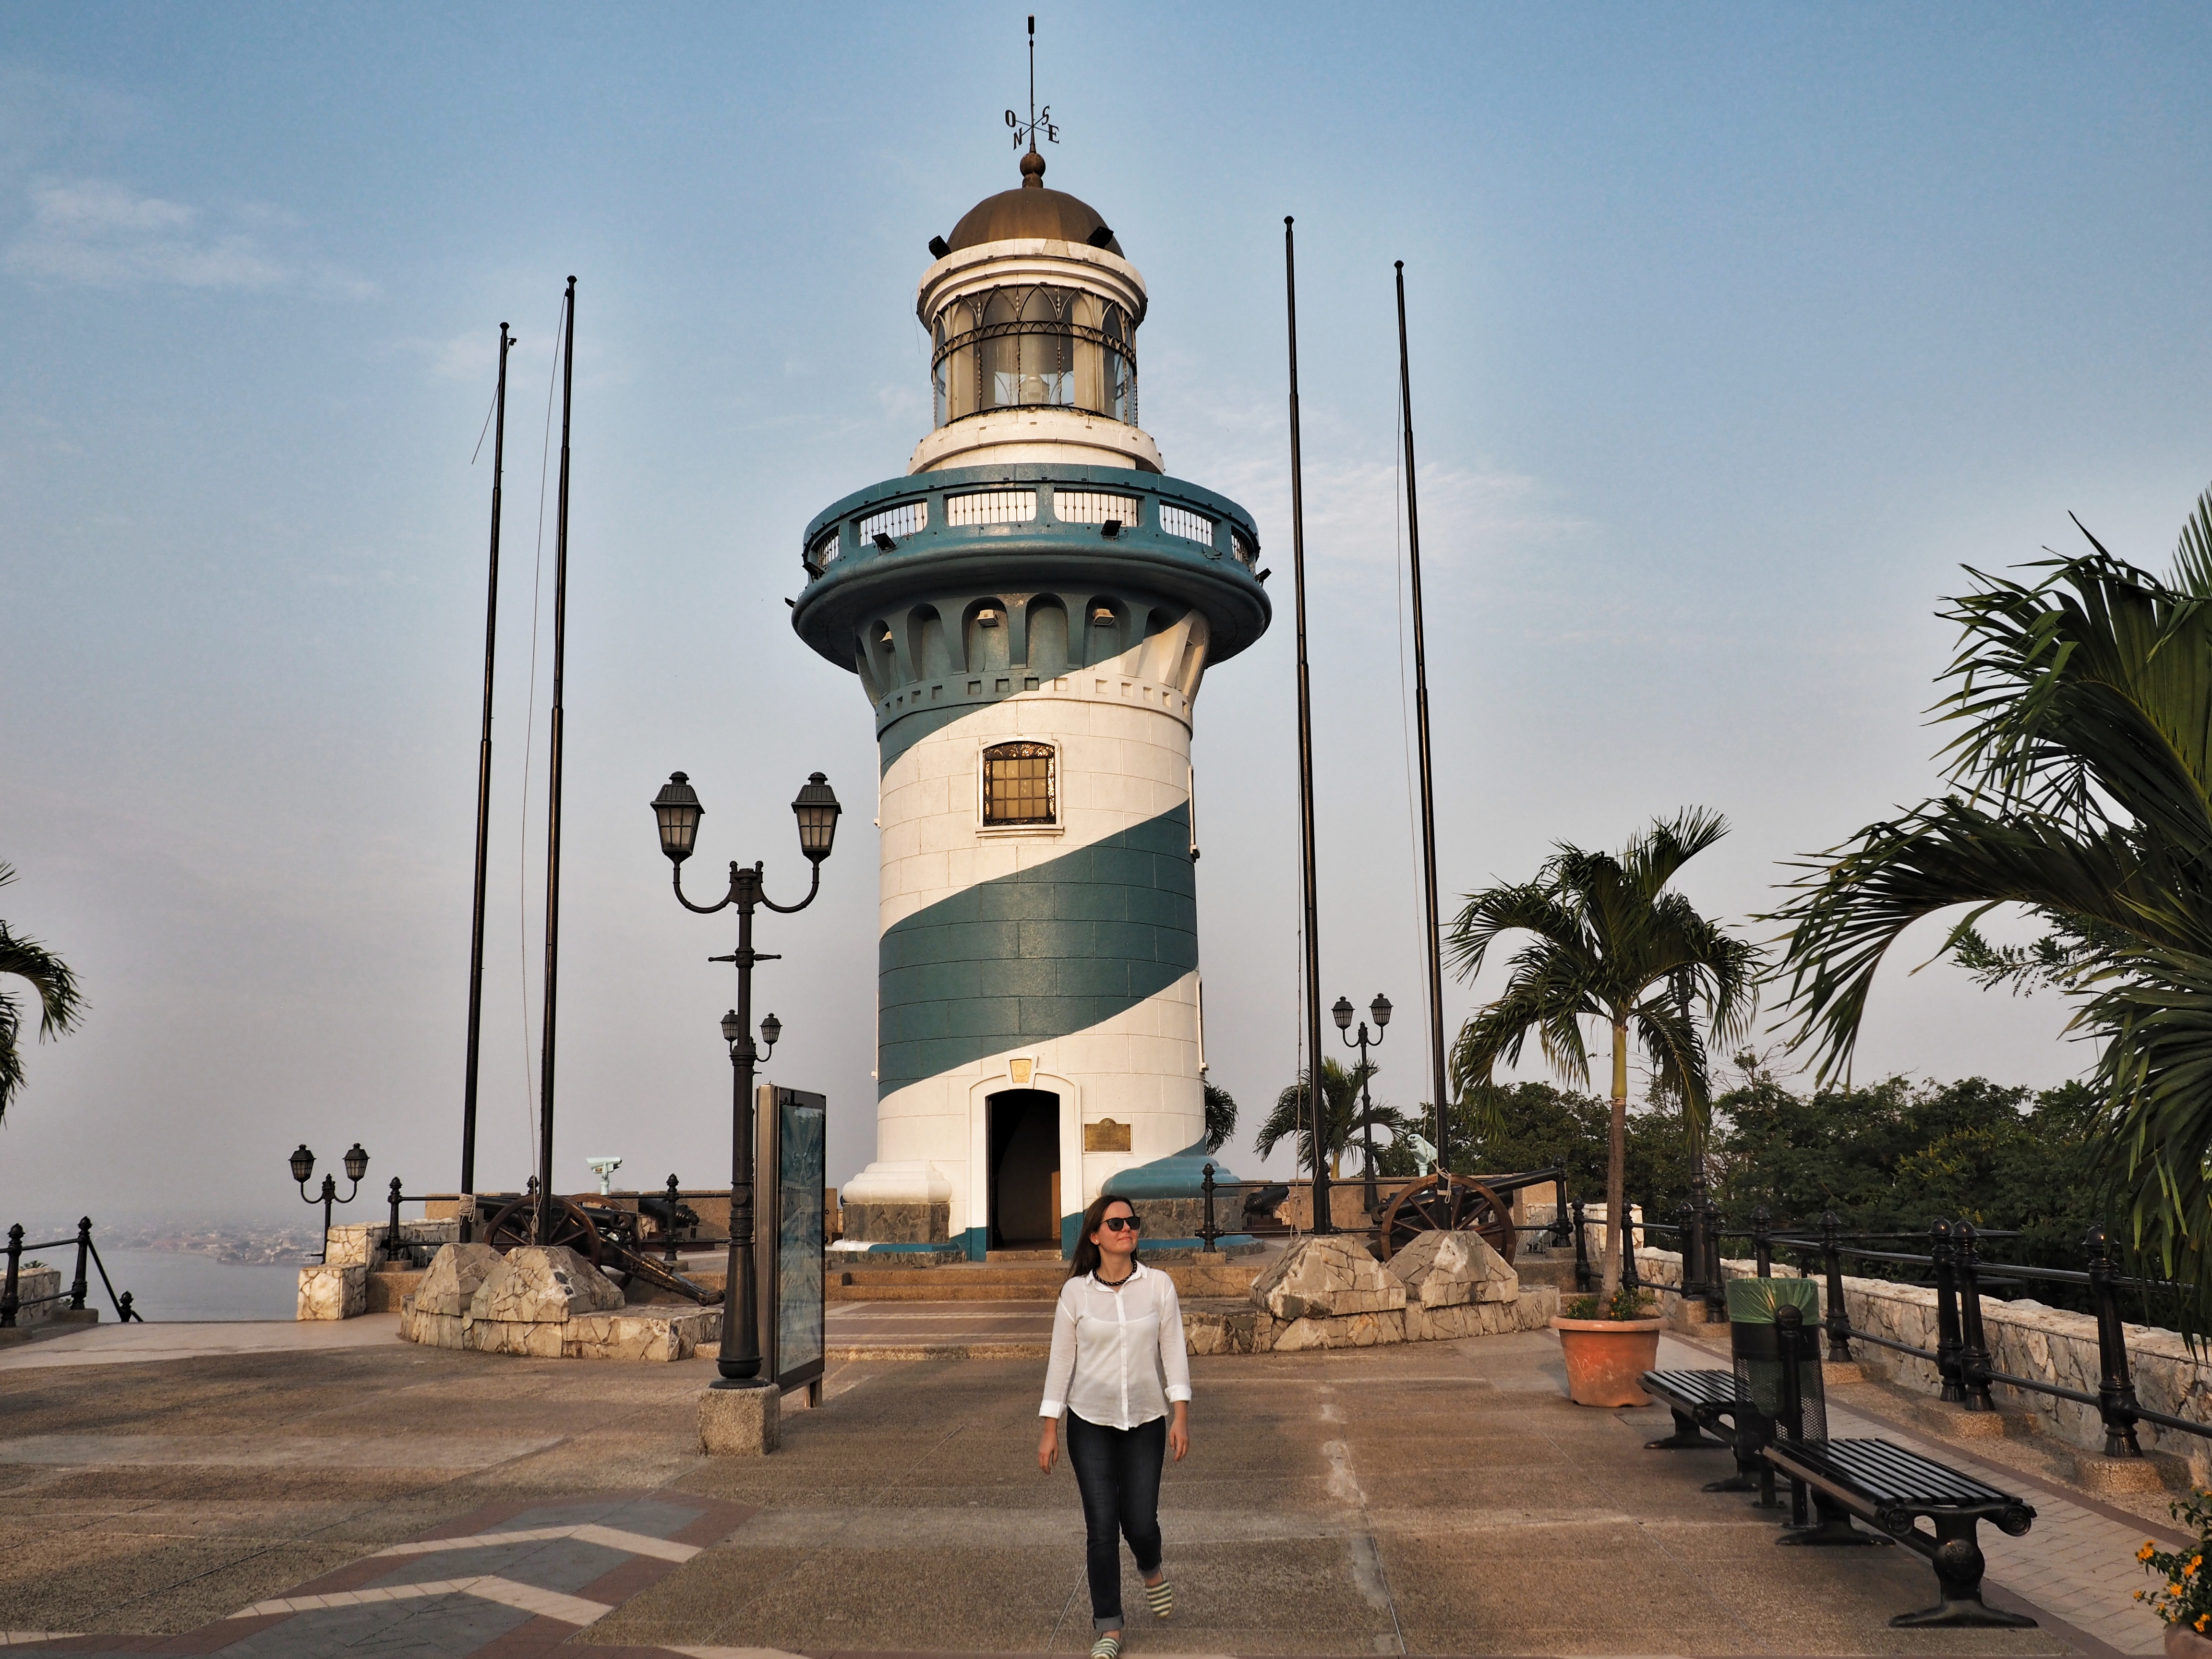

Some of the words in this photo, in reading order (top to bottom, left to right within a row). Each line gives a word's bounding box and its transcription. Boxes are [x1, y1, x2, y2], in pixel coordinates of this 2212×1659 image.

[1005, 109, 1016, 128] O
[1042, 104, 1050, 126] S
[1013, 127, 1022, 150] N
[1047, 123, 1059, 144] E
